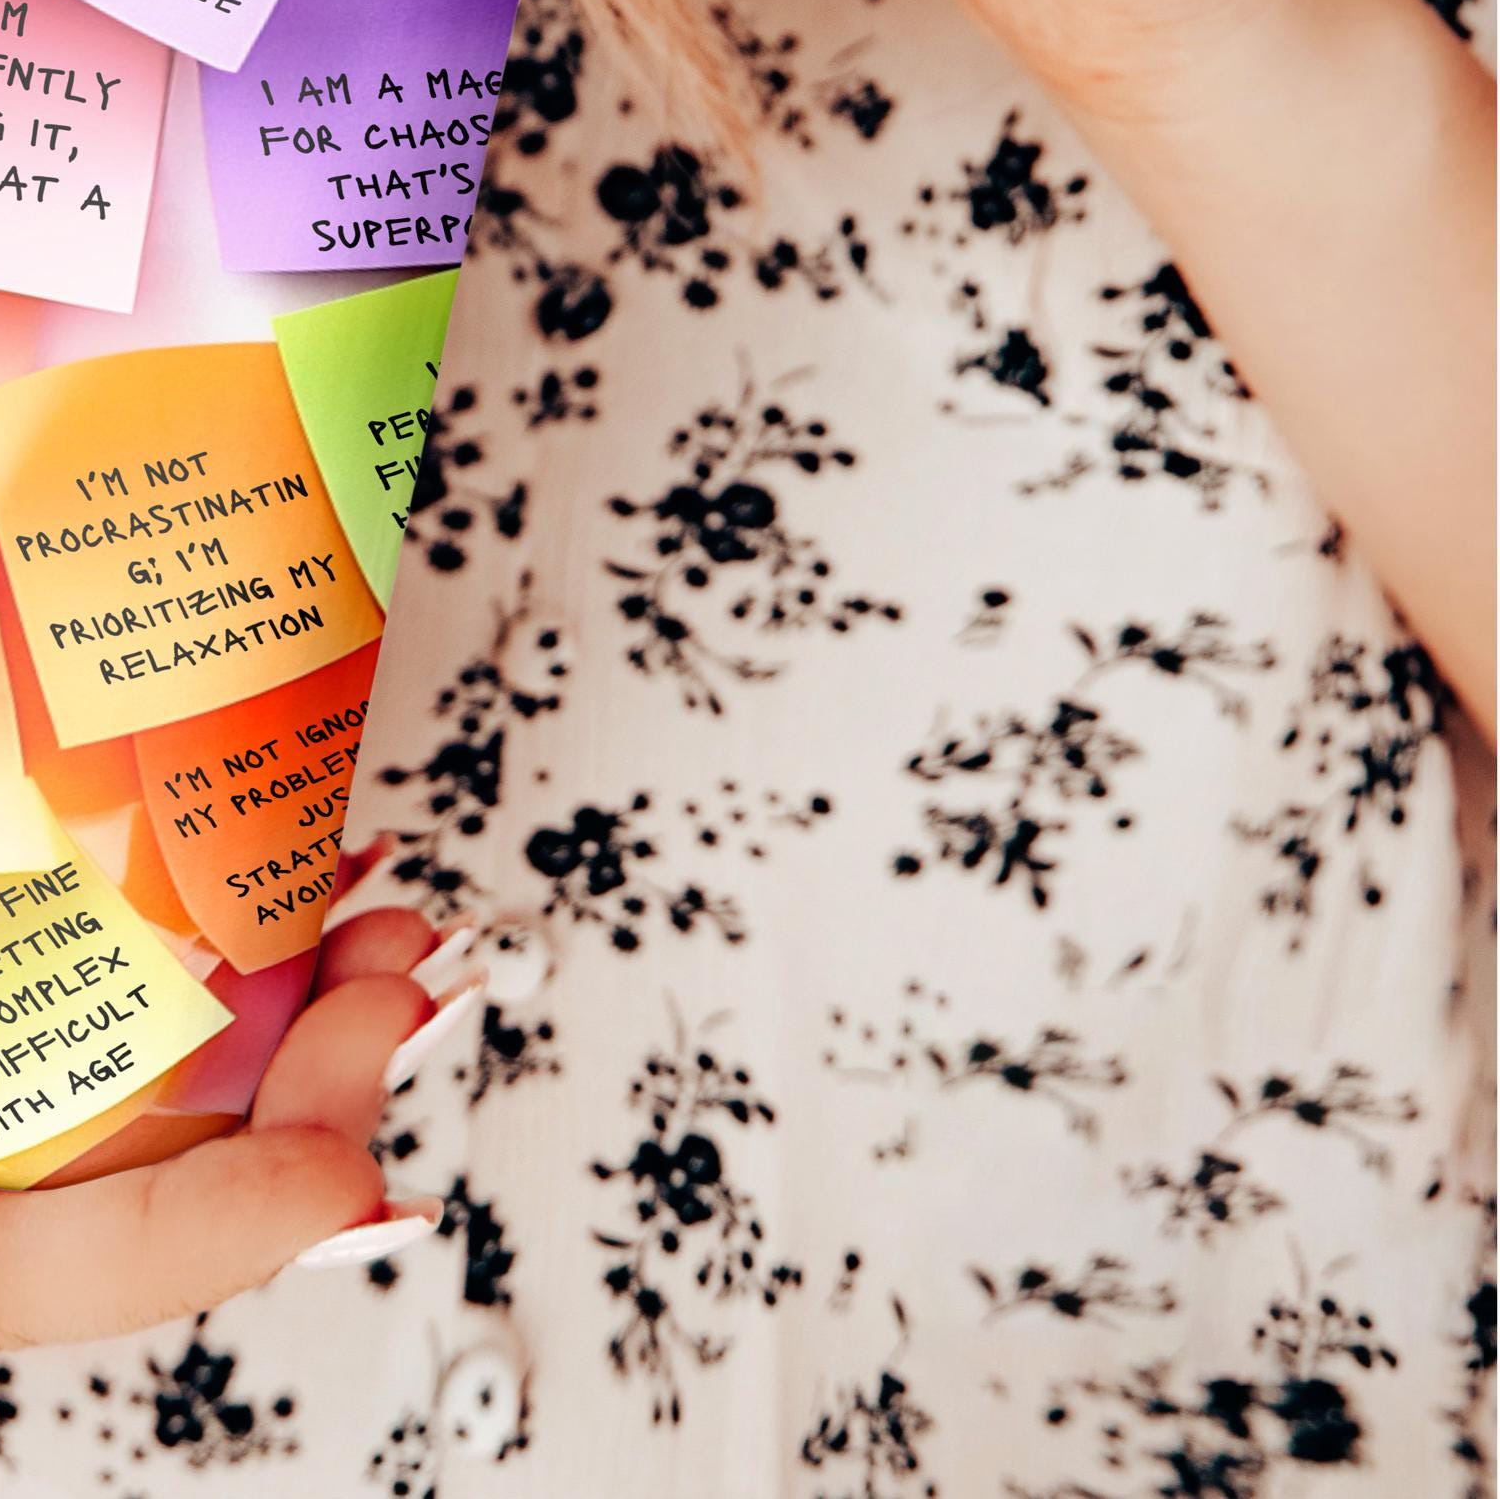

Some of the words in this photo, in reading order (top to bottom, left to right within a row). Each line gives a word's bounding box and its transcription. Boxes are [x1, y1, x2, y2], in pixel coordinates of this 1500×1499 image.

[261, 79, 274, 106] I
[298, 73, 352, 107] AM
[378, 73, 403, 104] A
[30, 119, 78, 163] IT,
[259, 124, 342, 157] FOR
[364, 114, 491, 150] CHAOS
[80, 184, 111, 220] A
[327, 162, 475, 200] THAT'S
[76, 467, 129, 501] I'M
[143, 451, 208, 487] NOT
[15, 473, 309, 562] PROCRASTINATIN
[175, 537, 229, 574] I'M
[49, 576, 275, 650] PRIORITIZING
[288, 553, 340, 588] MY
[99, 605, 324, 685] RELAXATION
[164, 766, 213, 800] I'M
[222, 739, 280, 778] NOT
[173, 803, 218, 839] MY
[67, 1041, 135, 1096] AGE
